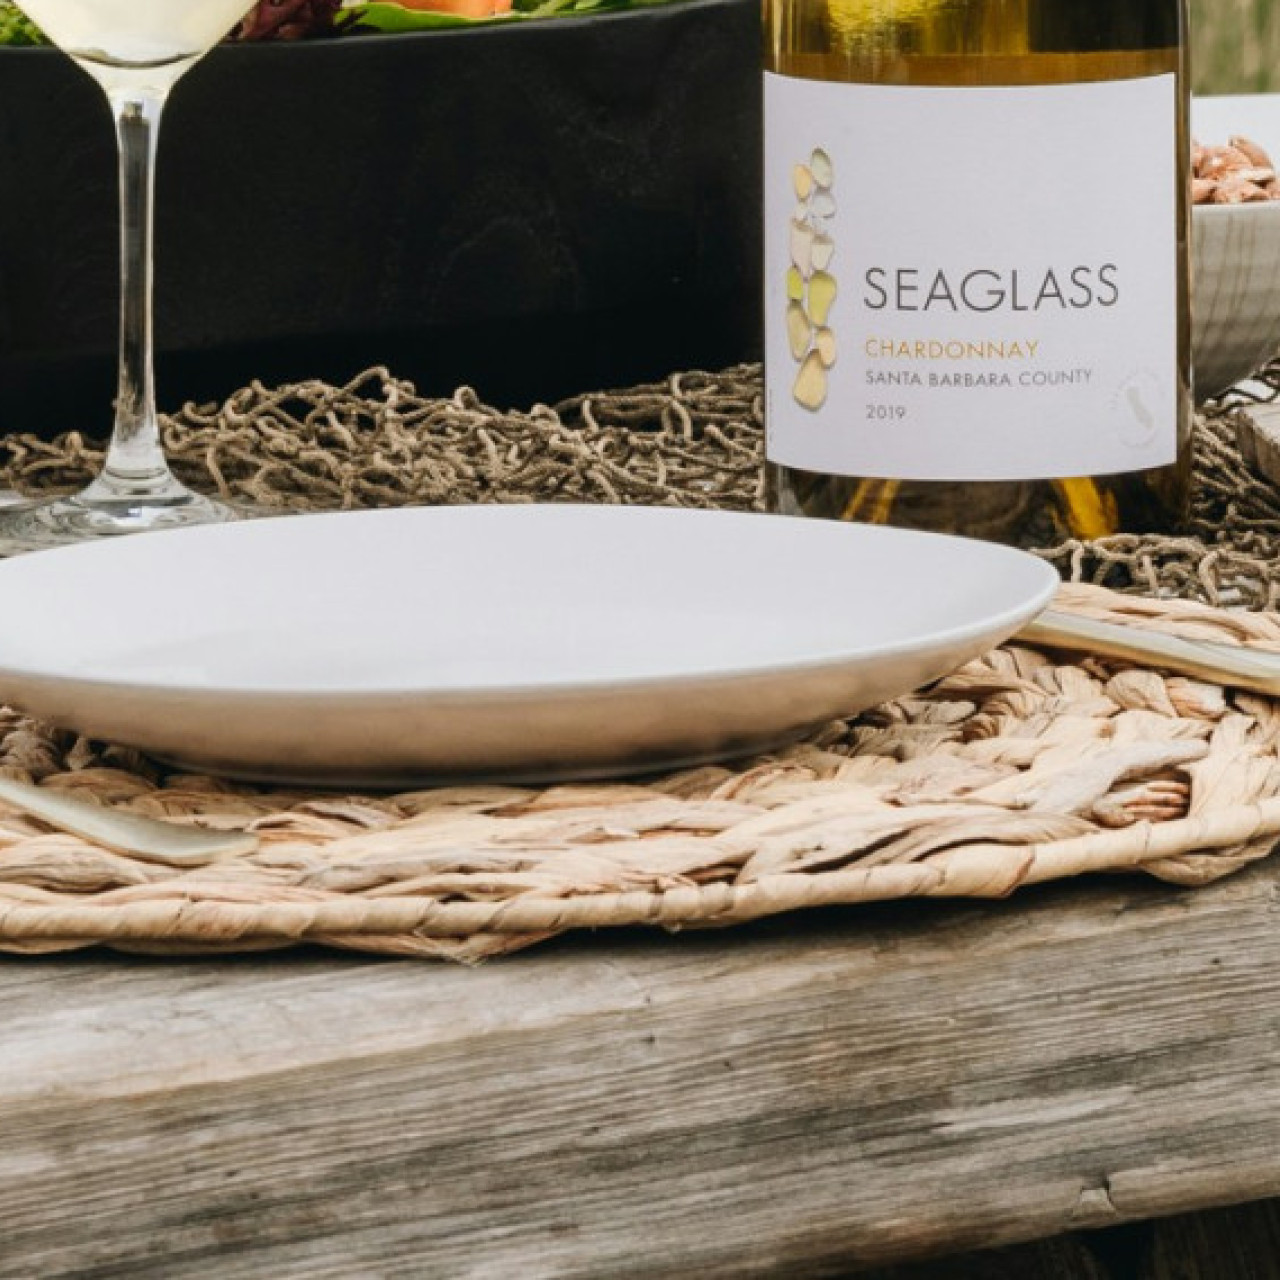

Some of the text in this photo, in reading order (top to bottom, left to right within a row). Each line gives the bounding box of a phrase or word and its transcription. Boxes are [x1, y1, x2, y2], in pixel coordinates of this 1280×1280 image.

[864, 263, 1119, 312] SEAGLASS
[864, 339, 1039, 360] CHARDONNAY
[865, 367, 1093, 388] SANTA BARBARA COUNTY
[865, 403, 906, 420] 2019
